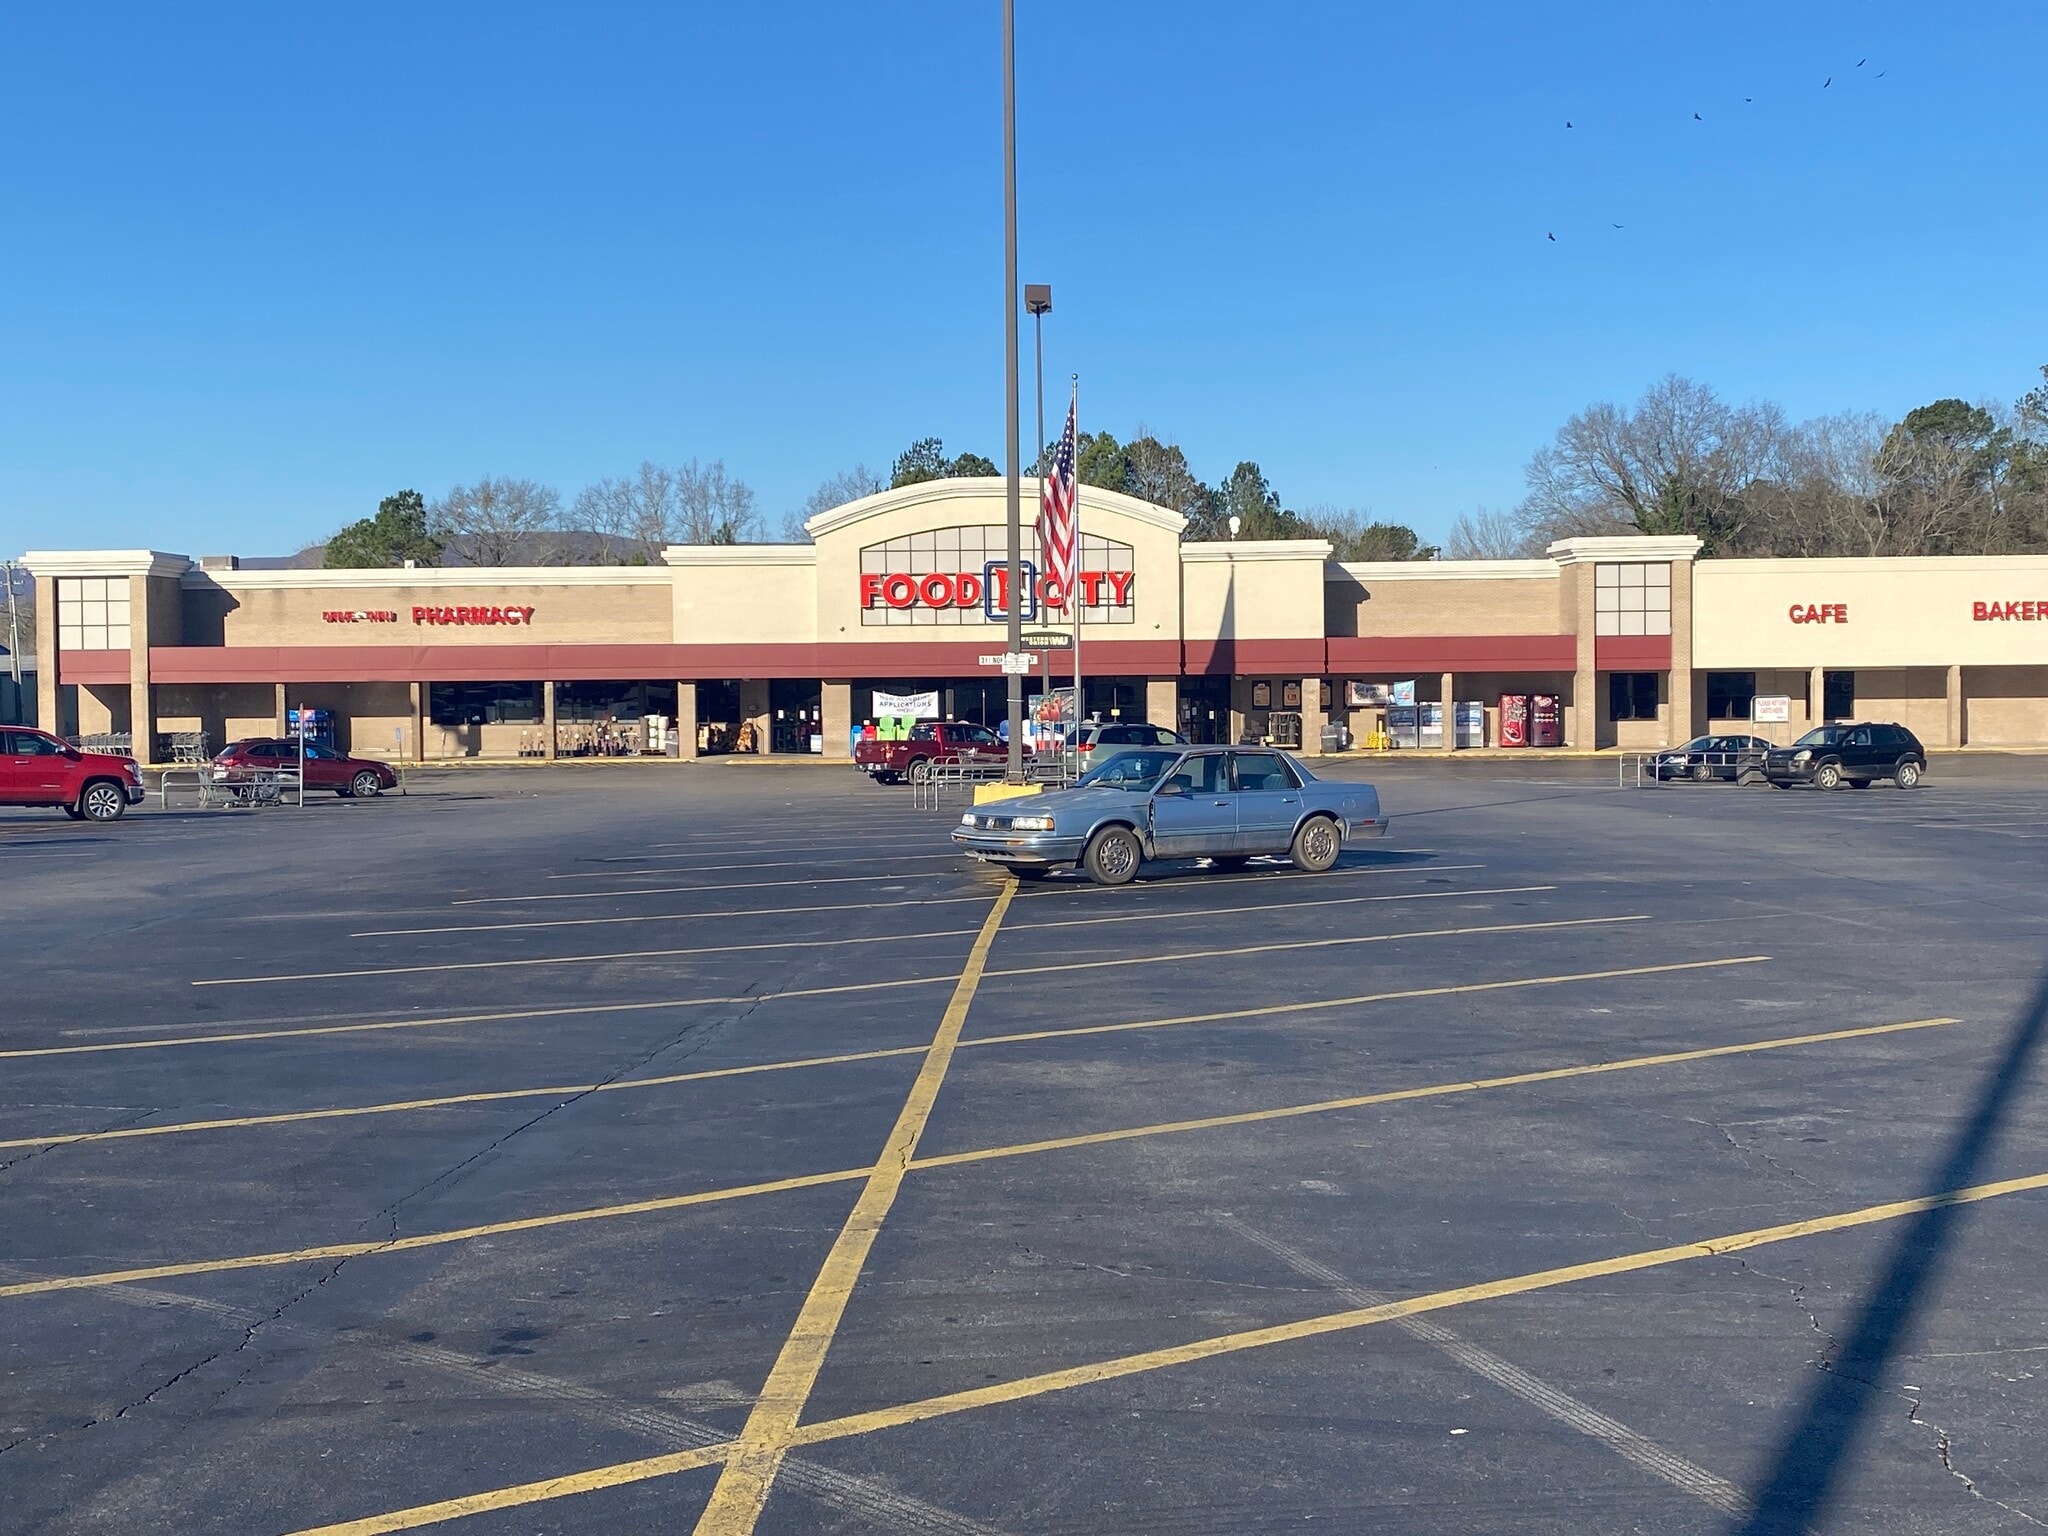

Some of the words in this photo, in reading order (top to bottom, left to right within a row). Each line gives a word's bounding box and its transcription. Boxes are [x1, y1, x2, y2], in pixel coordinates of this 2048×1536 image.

[860, 573, 982, 608] FOOD
[1036, 571, 1134, 607] CTY
[412, 606, 535, 626] PHARMACY
[1789, 603, 1849, 624] CAFE
[1972, 601, 2048, 621] BAKER
